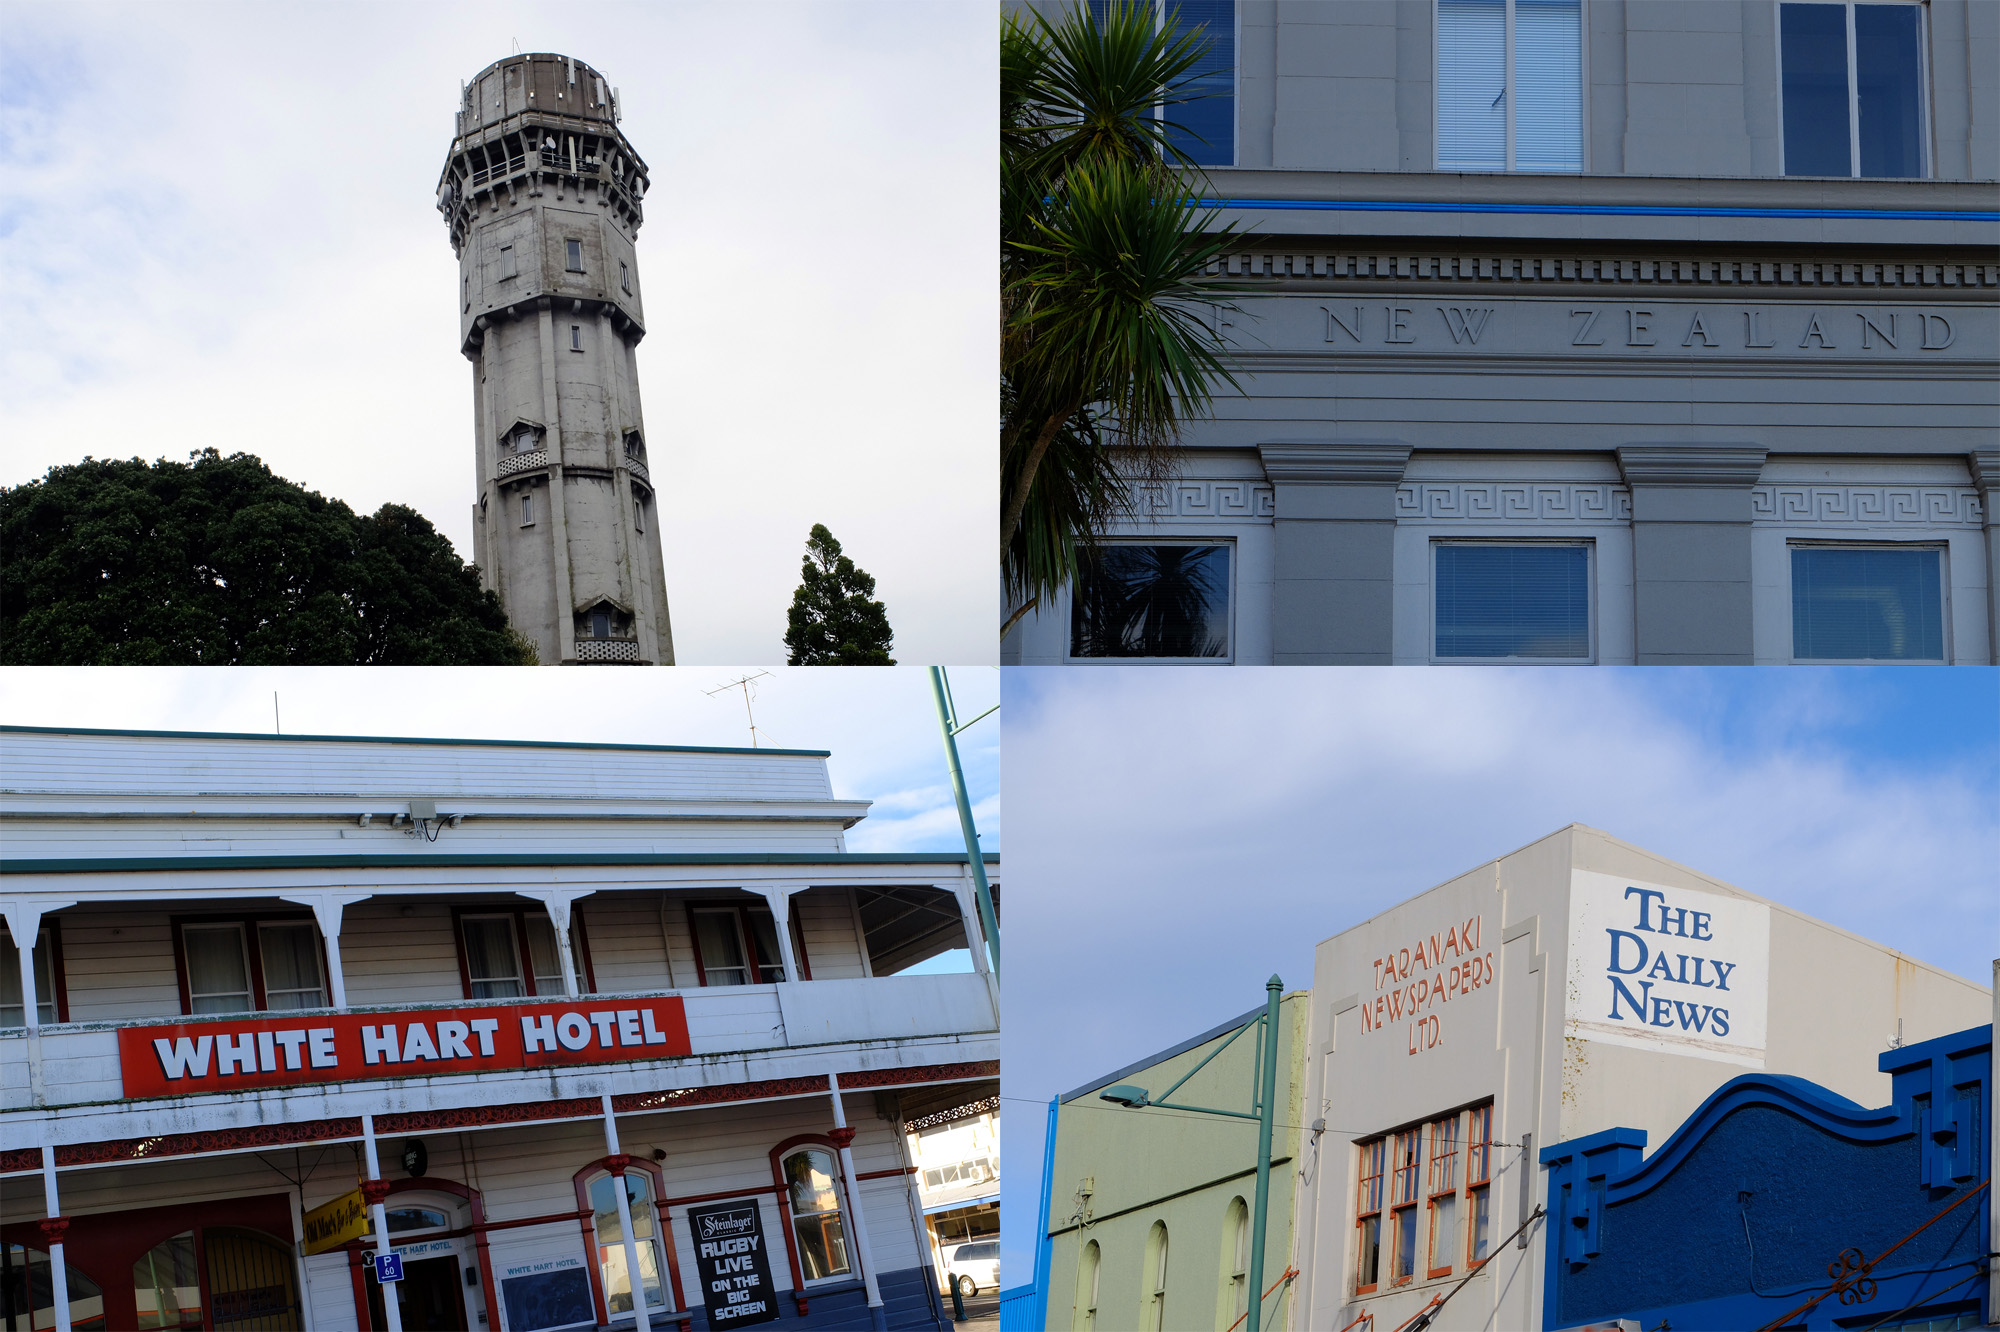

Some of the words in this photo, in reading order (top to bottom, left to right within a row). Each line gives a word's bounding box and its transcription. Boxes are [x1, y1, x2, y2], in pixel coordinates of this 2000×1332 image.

[1320, 306, 1494, 345] NEW
[1571, 309, 1957, 351] ZEALAND
[1374, 915, 1481, 991] TARANAKI
[1361, 952, 1493, 1035] NEWSPAPERS
[153, 1028, 337, 1079] WHITE
[361, 1018, 498, 1065] HART
[521, 1009, 667, 1054] HOTEL
[1409, 1015, 1443, 1056] LTD.
[703, 1213, 751, 1237] Steinlager
[390, 1246, 407, 1255] HITE
[410, 1244, 428, 1254] HART
[430, 1241, 452, 1251] HOTEL
[701, 1235, 759, 1258] RUGBY
[383, 1256, 392, 1267] P
[384, 1266, 394, 1275] 60
[507, 1265, 531, 1275] WHITE
[534, 1262, 553, 1271] HART
[556, 1258, 579, 1268] HOTEL
[715, 1255, 753, 1275] LIVE
[712, 1279, 731, 1292] ON
[733, 1274, 760, 1288] THE
[727, 1289, 750, 1304] BIG
[714, 1300, 766, 1320] SCREEN
